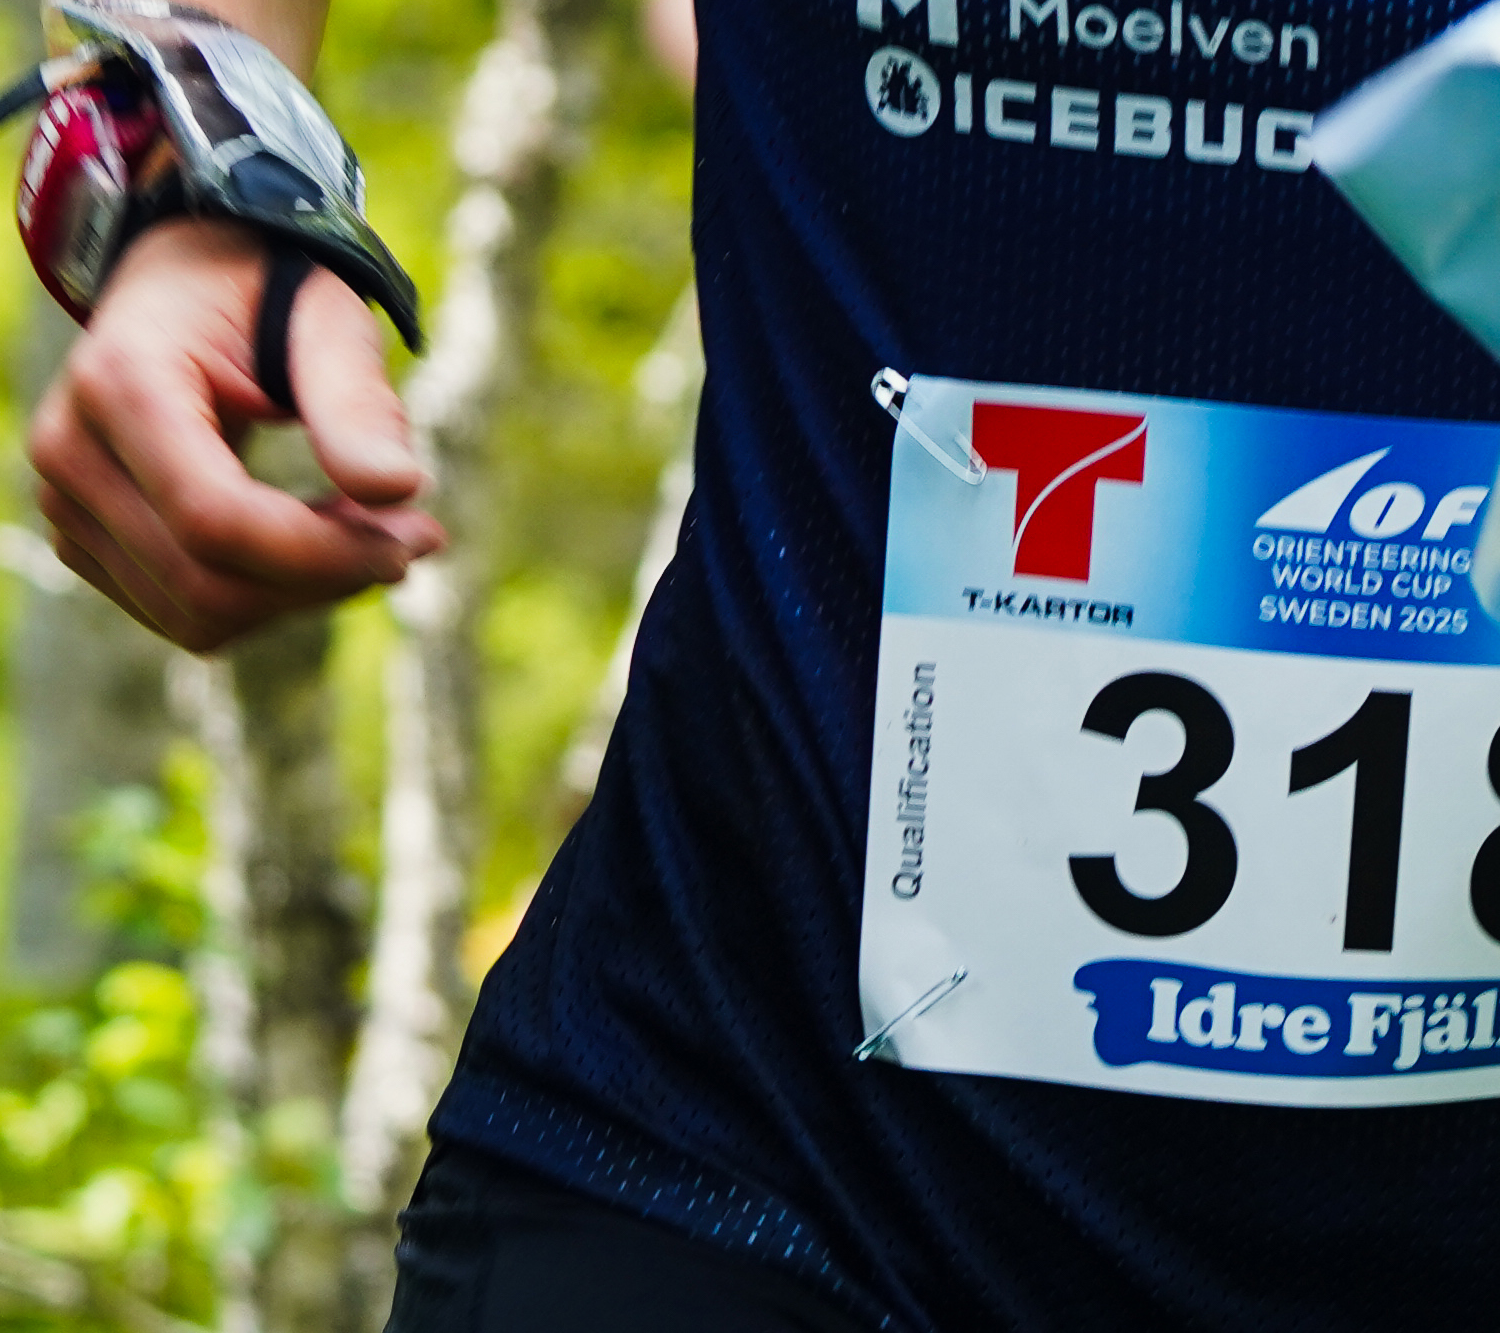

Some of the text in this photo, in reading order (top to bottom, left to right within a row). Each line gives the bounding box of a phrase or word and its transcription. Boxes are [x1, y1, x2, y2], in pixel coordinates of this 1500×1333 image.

[953, 71, 1318, 174] ICEBUG
[1252, 533, 1475, 575] ORIENTEERING
[1271, 562, 1453, 600] WORLD CUP
[962, 587, 1135, 629] T-KARTOR
[1258, 594, 1469, 635] SWEDEN 2025
[891, 661, 937, 901] Qualification
[1146, 977, 1331, 1055] Idre
